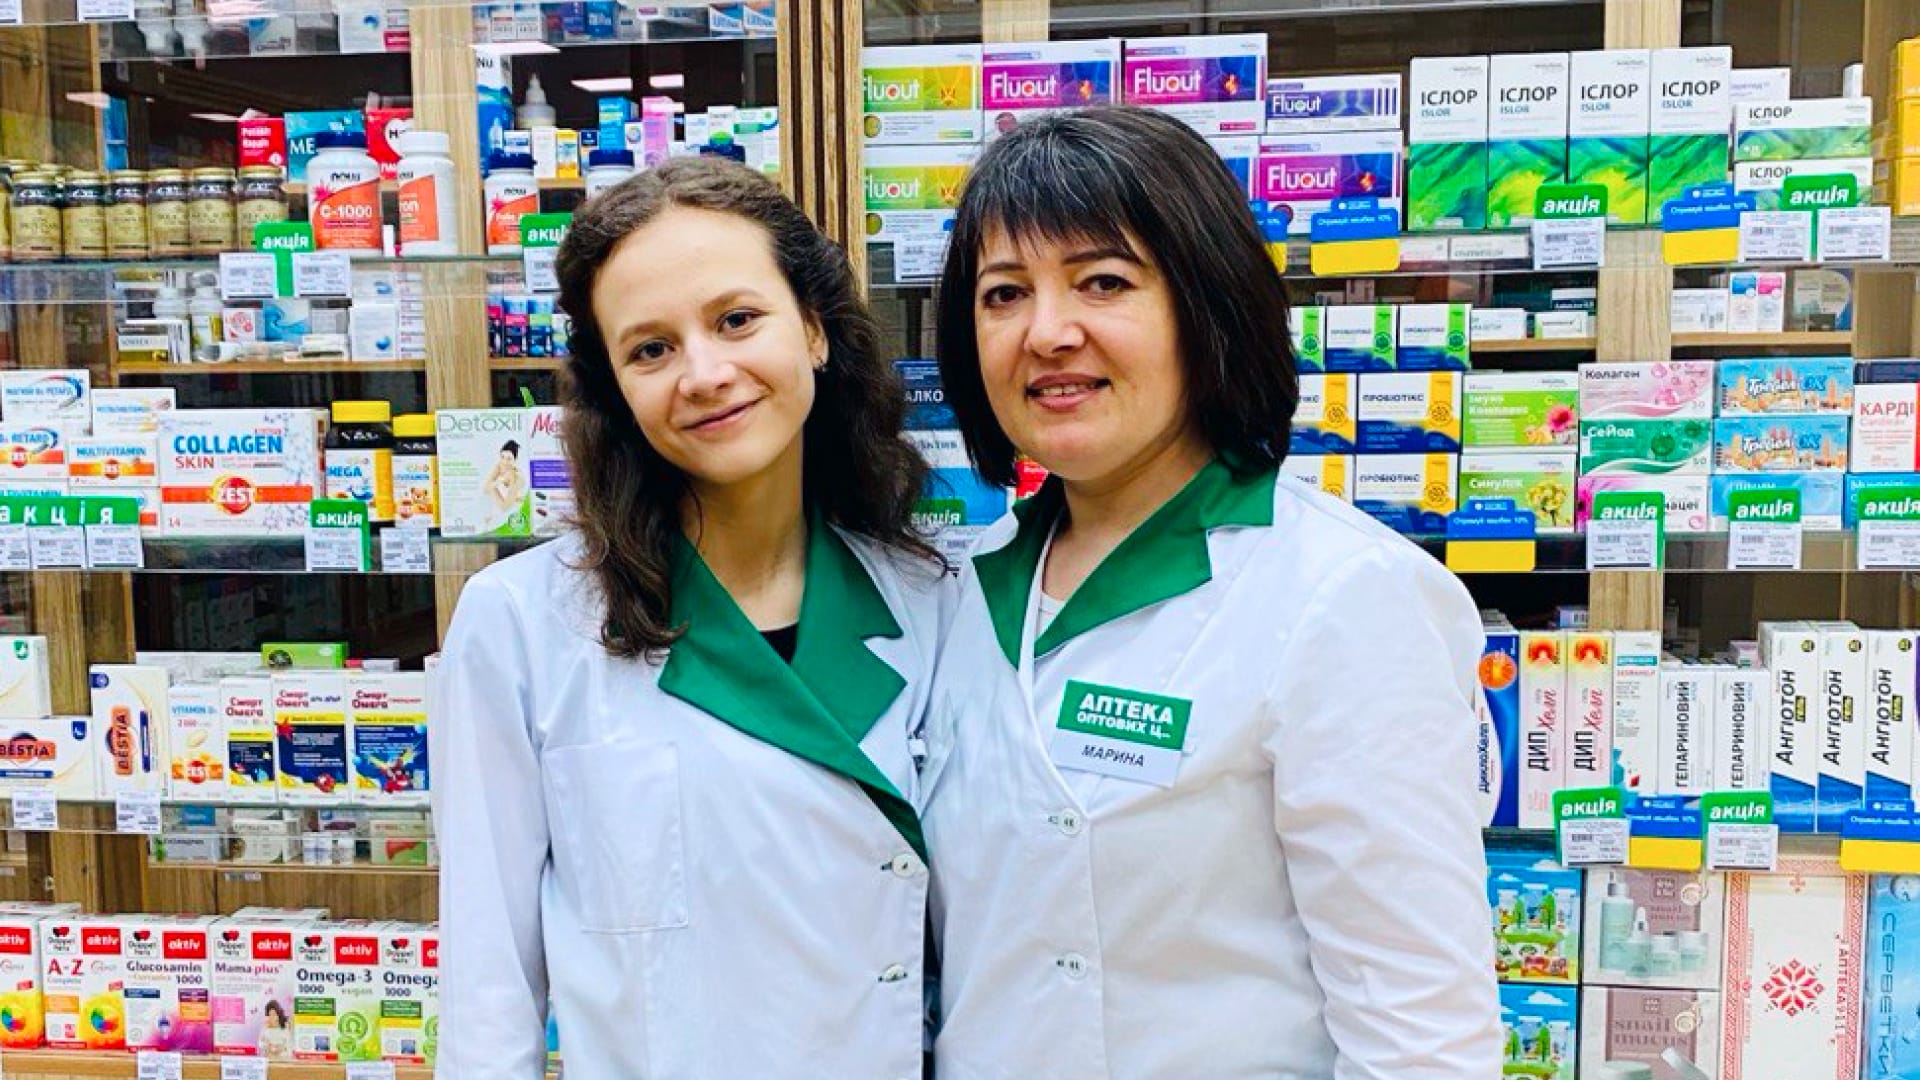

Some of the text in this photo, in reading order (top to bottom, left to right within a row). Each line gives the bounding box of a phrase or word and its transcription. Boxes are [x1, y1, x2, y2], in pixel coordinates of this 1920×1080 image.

[991, 71, 1057, 98] Fluout
[1134, 66, 1201, 94] Fluout
[1662, 80, 1721, 97] ІСЛОР
[1420, 89, 1478, 105] ІСЛОР
[1499, 86, 1557, 102] ІСЛОР
[1580, 84, 1639, 100] ІСЛОР
[1272, 95, 1322, 113] Fluout
[1421, 108, 1450, 117] ISLOR
[1500, 105, 1530, 114] ISLOR
[1581, 102, 1611, 112] ISLOR
[1662, 99, 1693, 109] ISLOR
[1749, 107, 1792, 119] ІСЛОР
[1268, 162, 1338, 191] Fluout
[864, 173, 919, 198] luout
[1790, 185, 1849, 206] акція
[319, 204, 373, 218] C-1000
[1542, 195, 1601, 215] акція
[261, 232, 310, 250] акція
[1585, 368, 1640, 380] Колаген
[438, 412, 522, 433] Detoxil
[174, 435, 283, 454] COLLAGEN
[175, 455, 215, 469] SKIN
[1601, 503, 1658, 520] акція
[1736, 499, 1793, 518] акція
[315, 510, 363, 525] акція
[1079, 693, 1174, 725] АПТЕКА
[1077, 711, 1147, 734] ОПТОВИХ
[1674, 680, 1690, 788] ГЕПАРИНОВИЙ
[1731, 680, 1746, 788] ГЕПАРИНОВИЙ
[1081, 744, 1144, 767] МАРИНА
[1527, 730, 1550, 771] ДИП
[1573, 730, 1596, 771] ДИП
[1560, 799, 1616, 816] акція
[1709, 802, 1767, 820] акція
[86, 934, 120, 946] aktiv
[167, 938, 200, 950] aktiv
[256, 940, 289, 951] aktiv
[339, 944, 373, 956] aktiv
[127, 960, 203, 972] Glucosamin
[215, 962, 252, 973] Mama
[175, 975, 203, 985] 1000
[296, 967, 373, 986] Omega-3
[298, 983, 325, 994] 1000
[385, 987, 412, 997] 1000
[1877, 912, 1897, 1075] СЕРВЕТКИ
